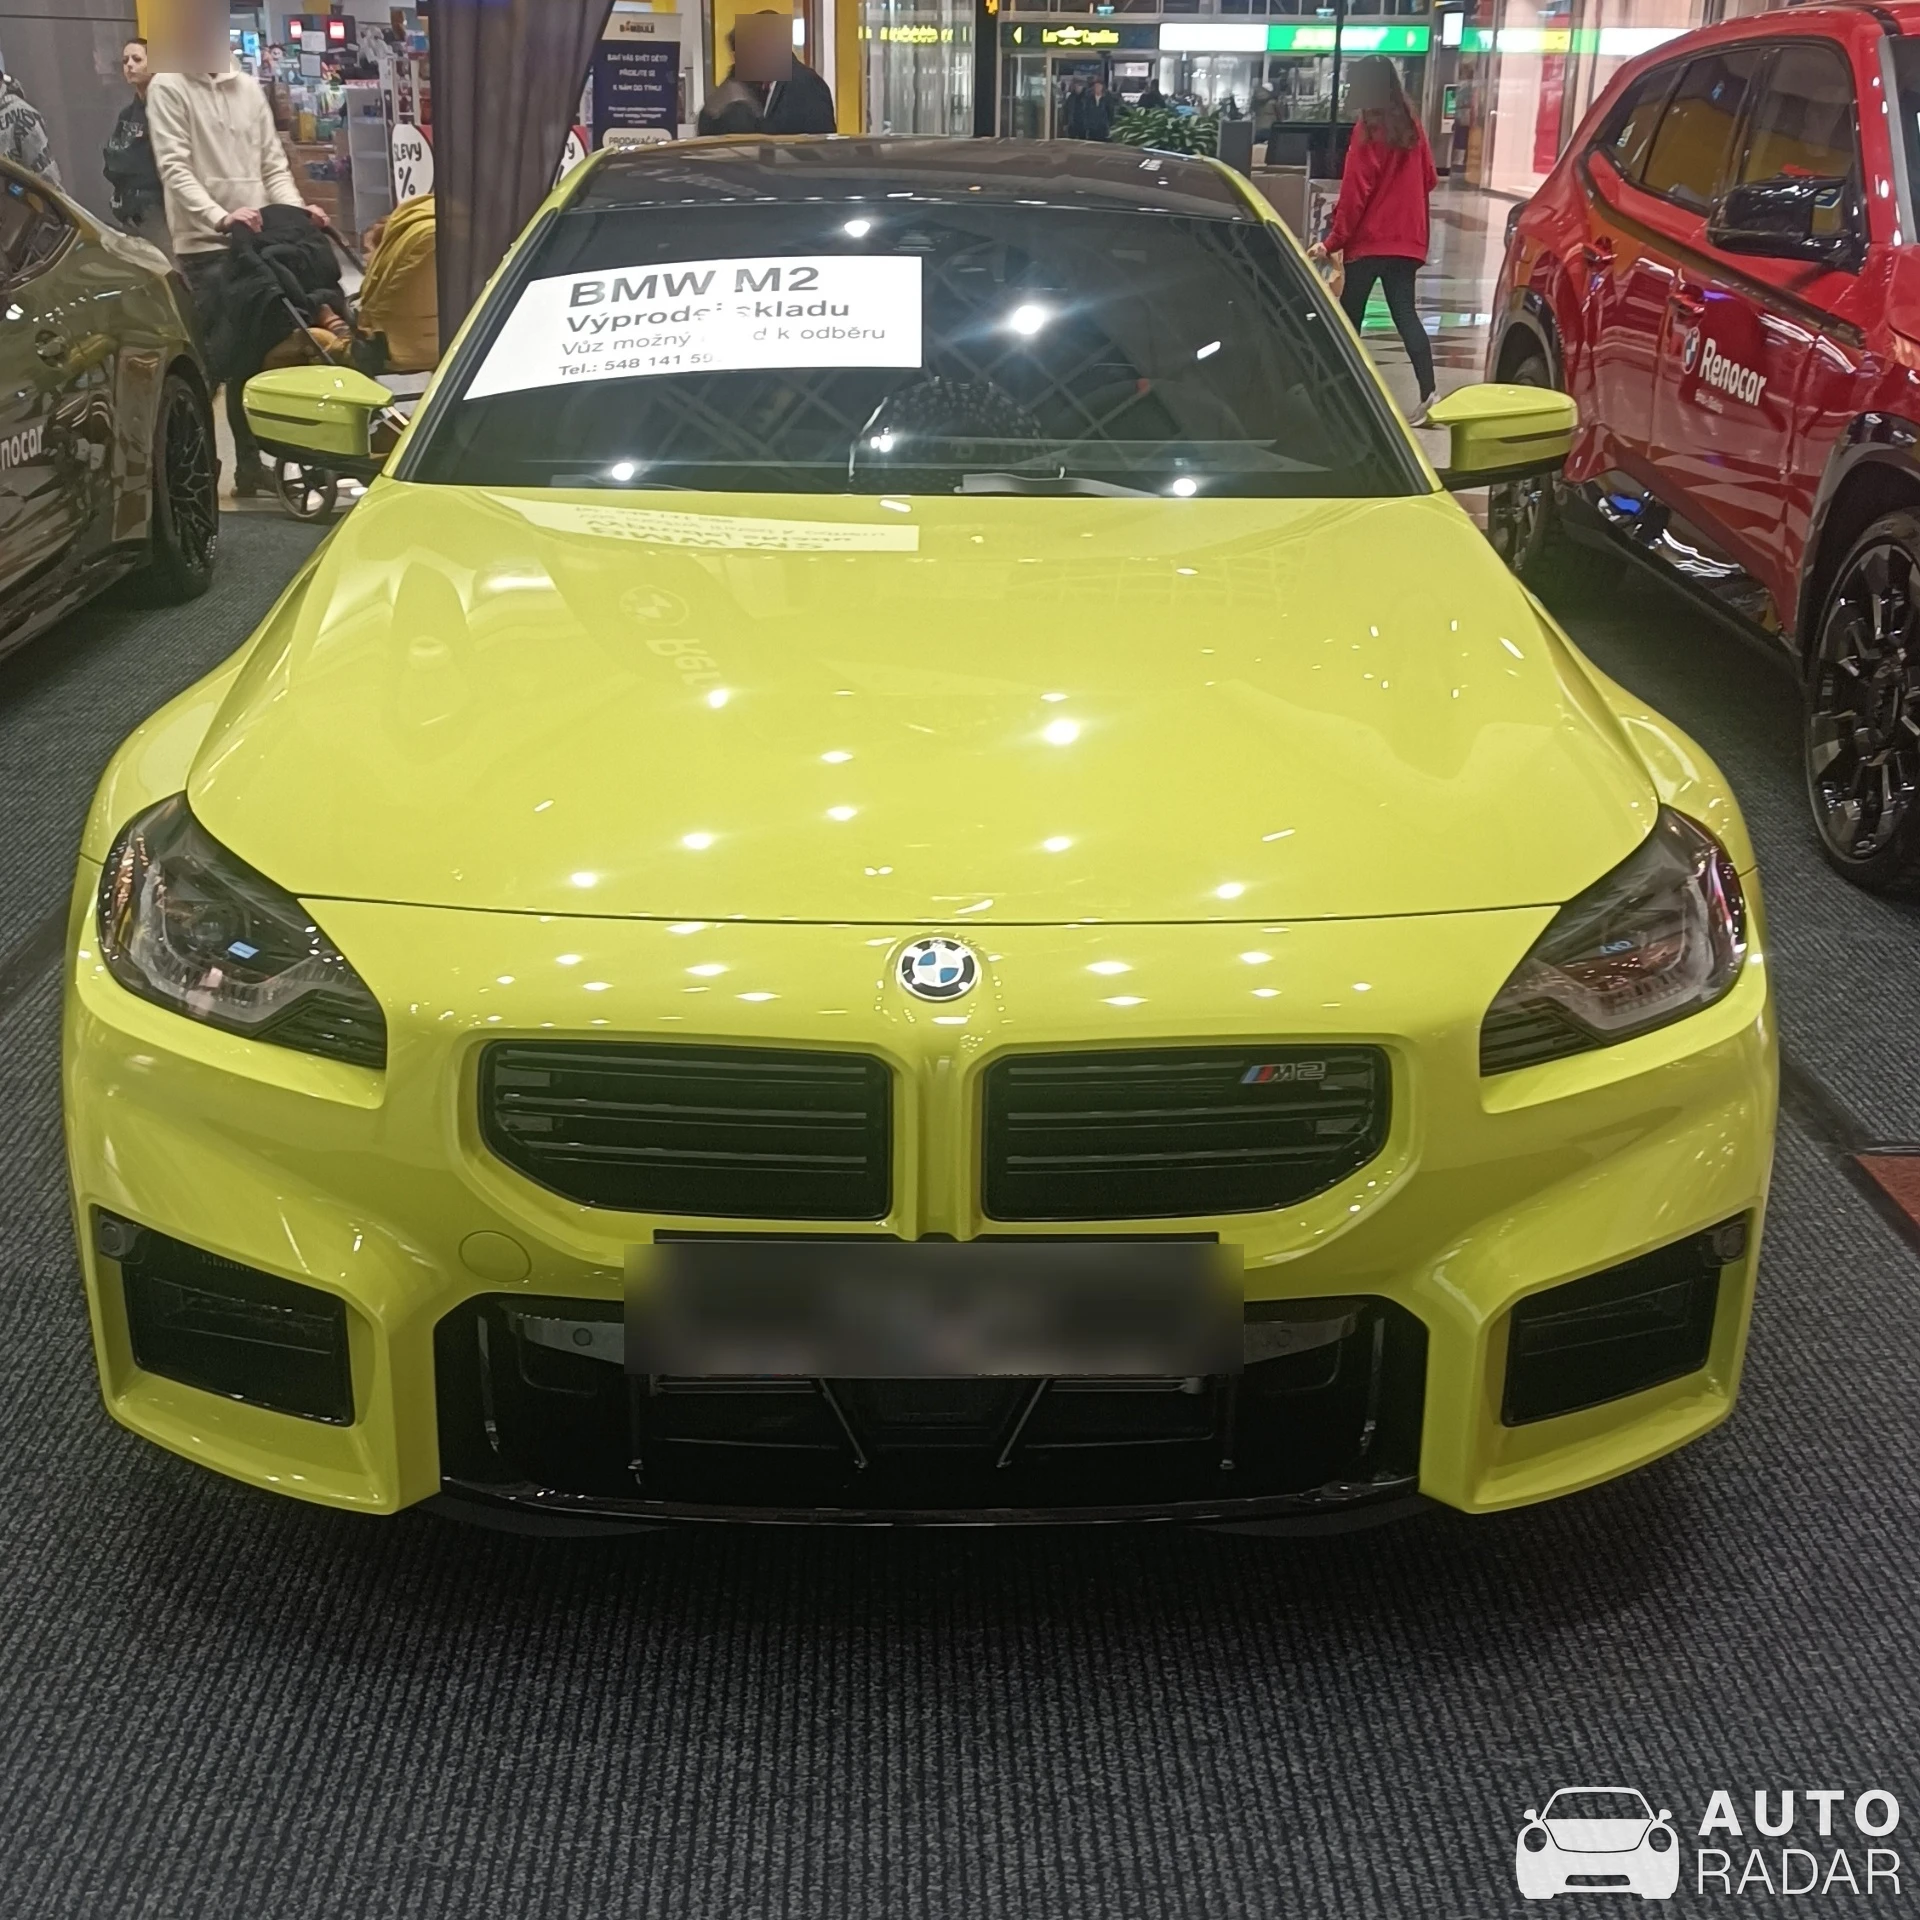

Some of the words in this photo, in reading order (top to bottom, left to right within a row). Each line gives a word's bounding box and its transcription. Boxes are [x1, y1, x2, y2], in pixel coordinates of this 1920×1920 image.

[569, 270, 717, 308] BMW
[733, 266, 819, 293] M2
[562, 340, 605, 356] Vůz
[613, 331, 692, 351] možný
[778, 327, 790, 340] k
[800, 326, 886, 340] odběru
[558, 362, 598, 376] Tel.:
[604, 358, 641, 371] 548
[648, 354, 682, 367] 141
[1698, 337, 1768, 407] Renocar
[0, 424, 44, 471] nocar
[1264, 1061, 1327, 1083] M2
